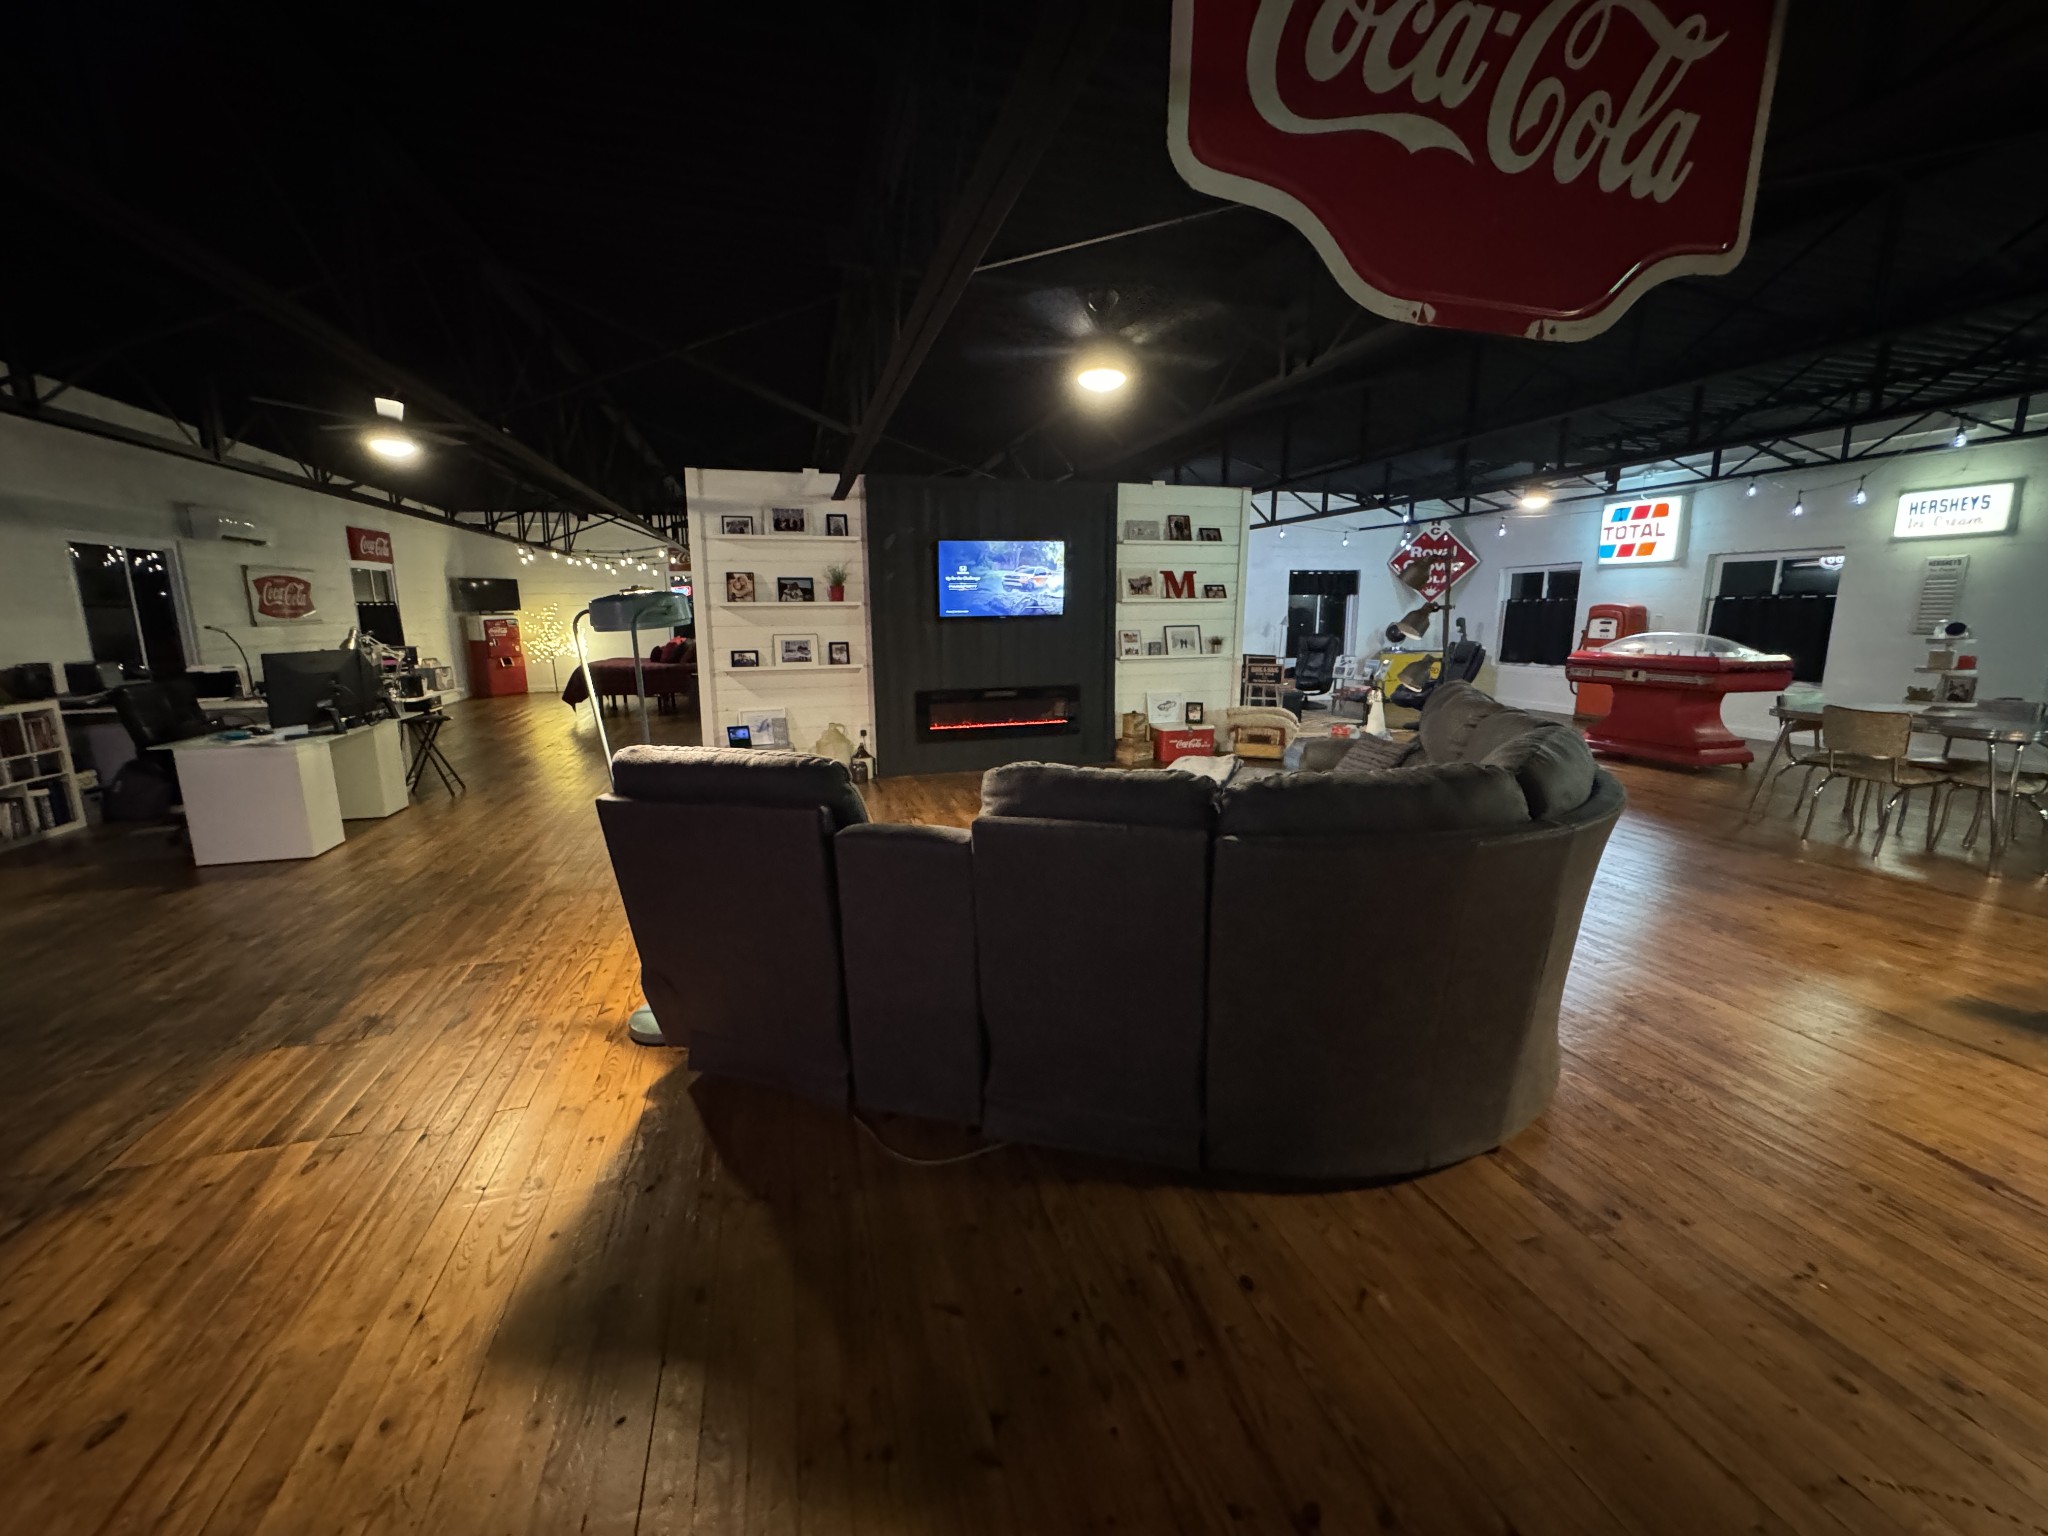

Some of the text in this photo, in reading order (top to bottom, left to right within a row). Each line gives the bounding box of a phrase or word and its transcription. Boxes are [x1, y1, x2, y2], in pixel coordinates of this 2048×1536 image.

[1933, 515, 1984, 527] Cream
[1603, 522, 1666, 541] TOTAL
[1159, 570, 1197, 599] M
